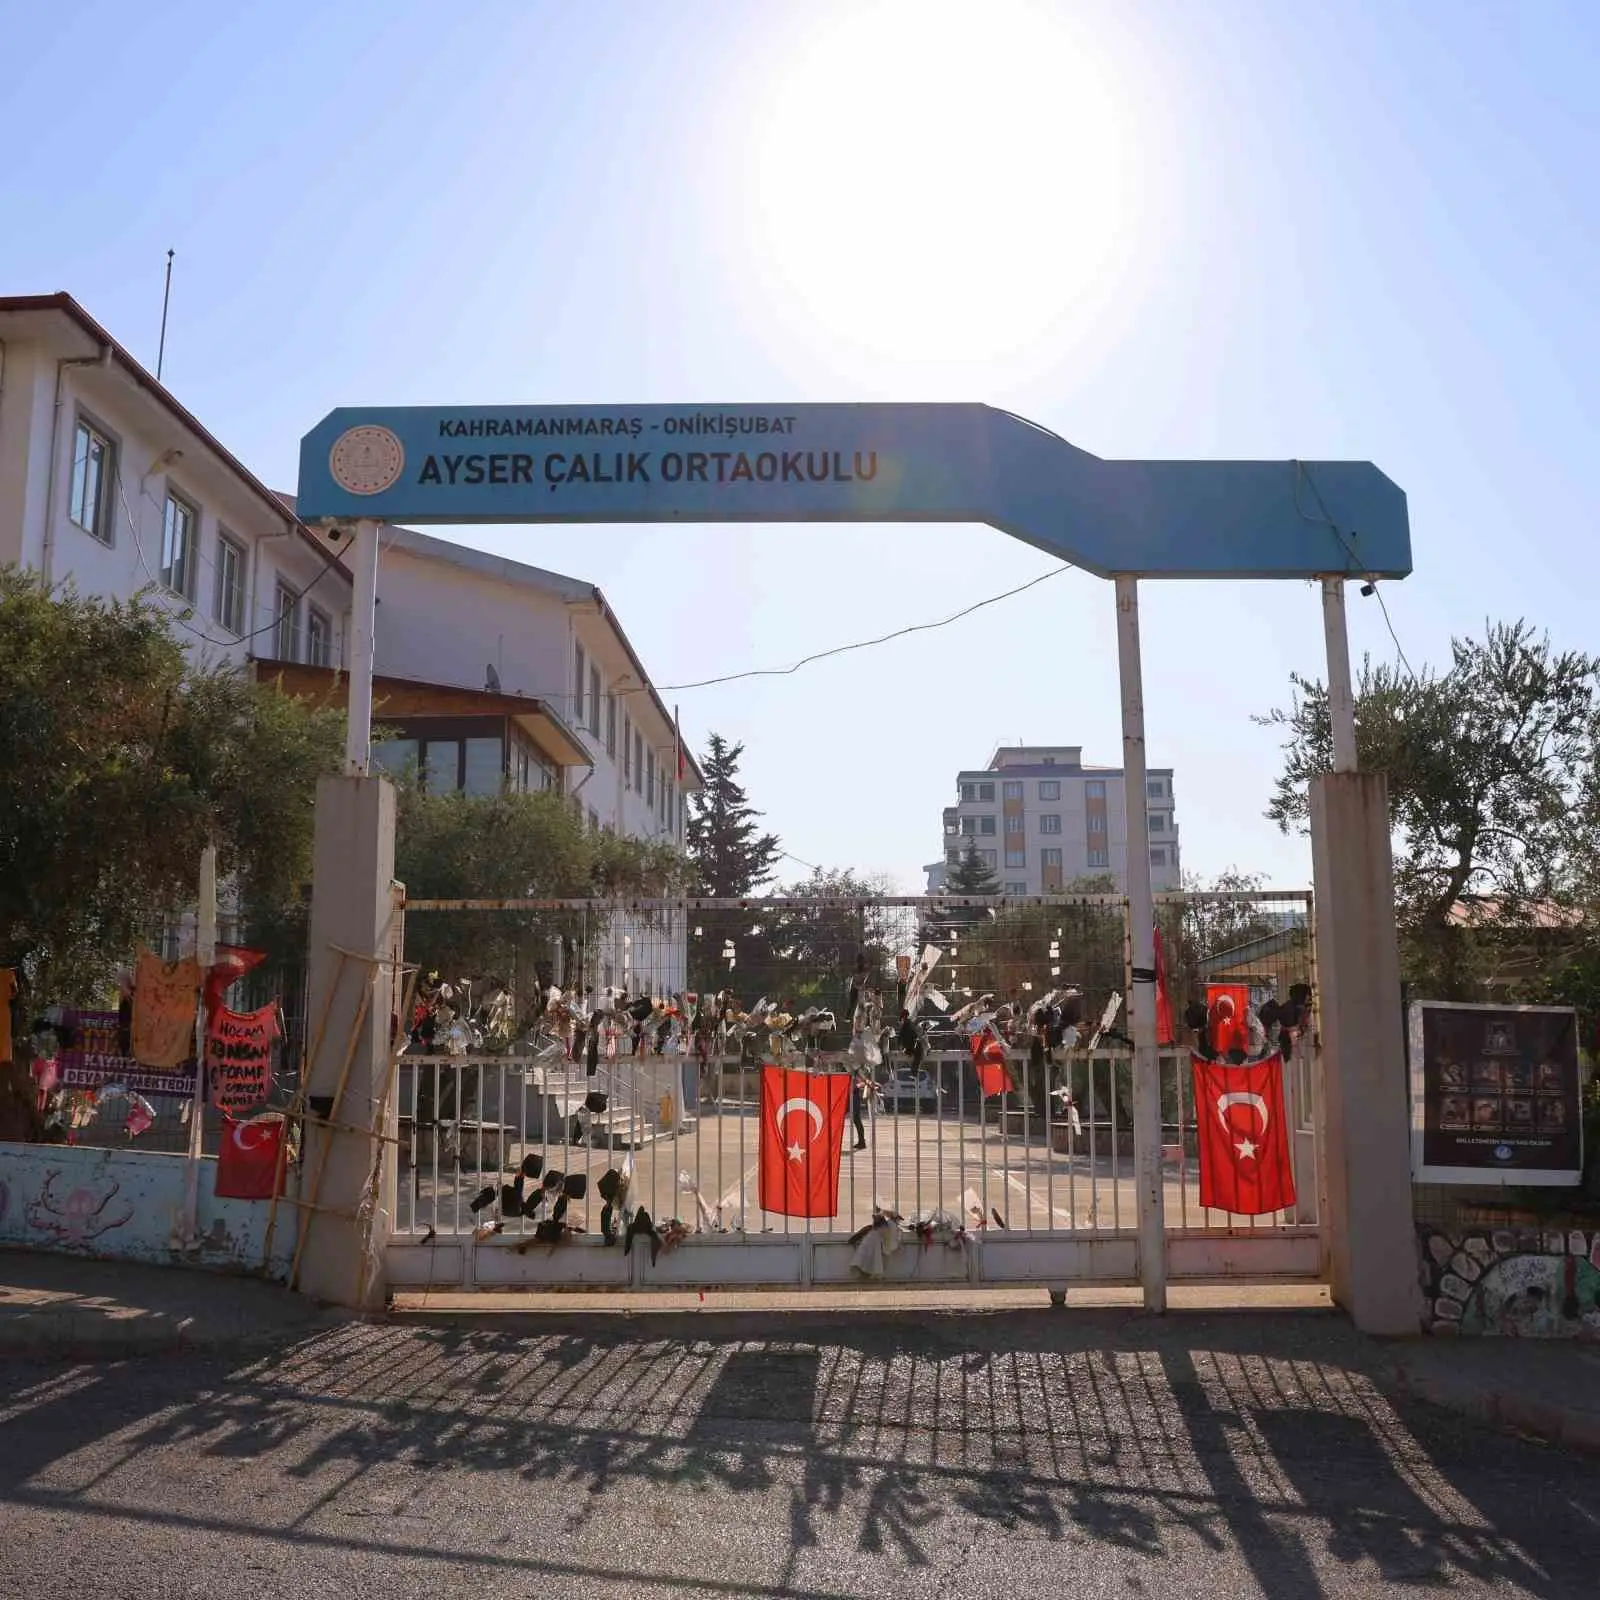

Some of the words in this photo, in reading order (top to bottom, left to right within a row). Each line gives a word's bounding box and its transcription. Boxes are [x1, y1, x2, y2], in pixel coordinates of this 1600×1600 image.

[439, 417, 643, 439] KAHRAMANMARAŞ
[663, 414, 796, 438] ONİKİŞUBAT
[417, 452, 533, 486] AYSER
[543, 451, 651, 492] ÇALIK
[660, 450, 878, 483] ORTAOKULU
